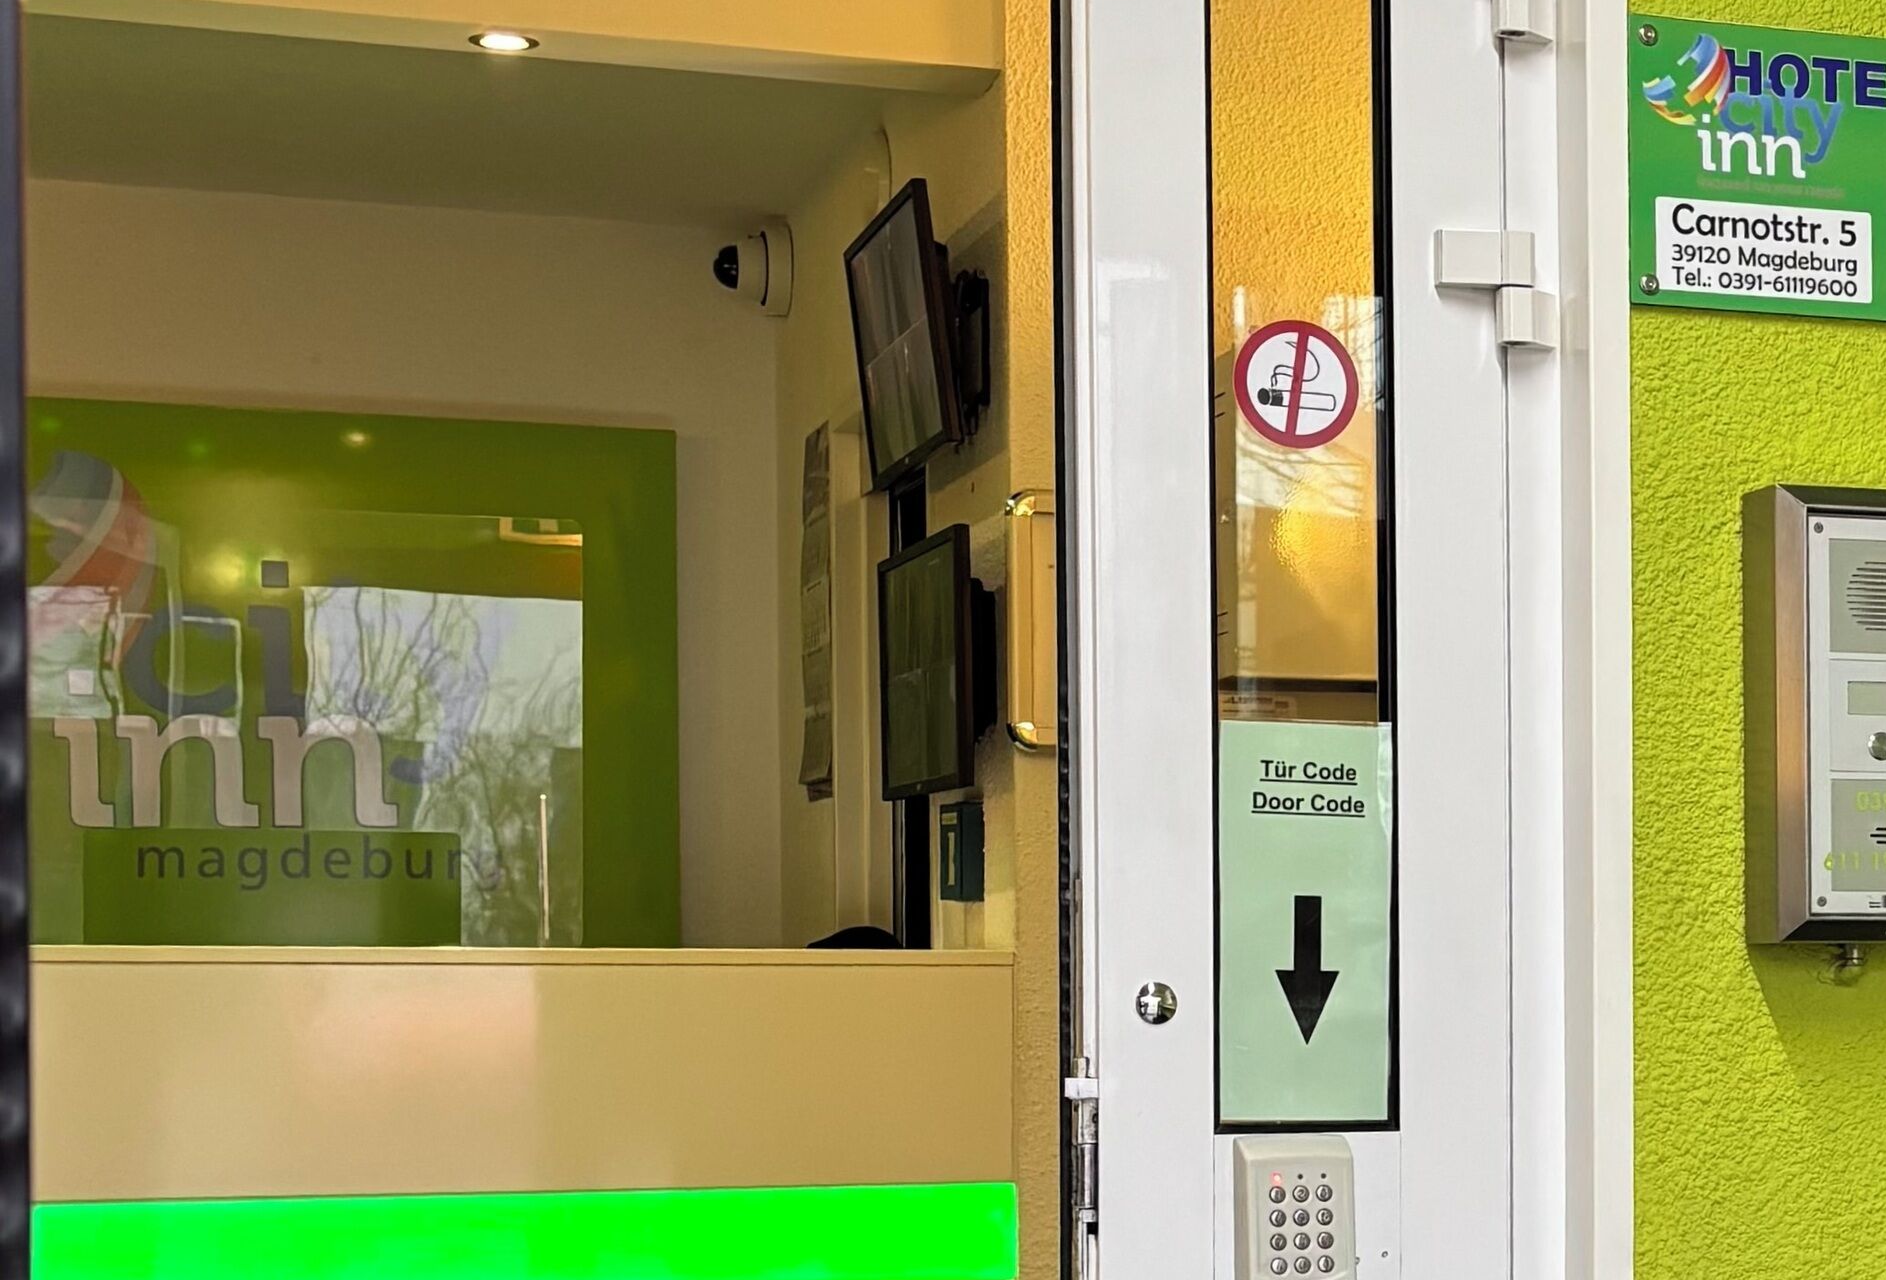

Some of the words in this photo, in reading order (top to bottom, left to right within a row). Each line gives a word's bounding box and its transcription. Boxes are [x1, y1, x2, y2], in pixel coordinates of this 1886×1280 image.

[1719, 78, 1843, 165] city
[1697, 113, 1806, 179] inn
[1671, 203, 1829, 245] Carnotstr.
[1839, 220, 1857, 247] 5
[1671, 244, 1731, 265] 39120
[1738, 246, 1858, 277] Magdeburg
[1671, 266, 1712, 288] Tel.:
[1718, 272, 1858, 298] 0391-61119600
[53, 669, 400, 829] inn
[1260, 759, 1297, 778] Tür
[1303, 761, 1357, 781] Code
[1252, 791, 1305, 811] Door
[1311, 794, 1365, 813] Code
